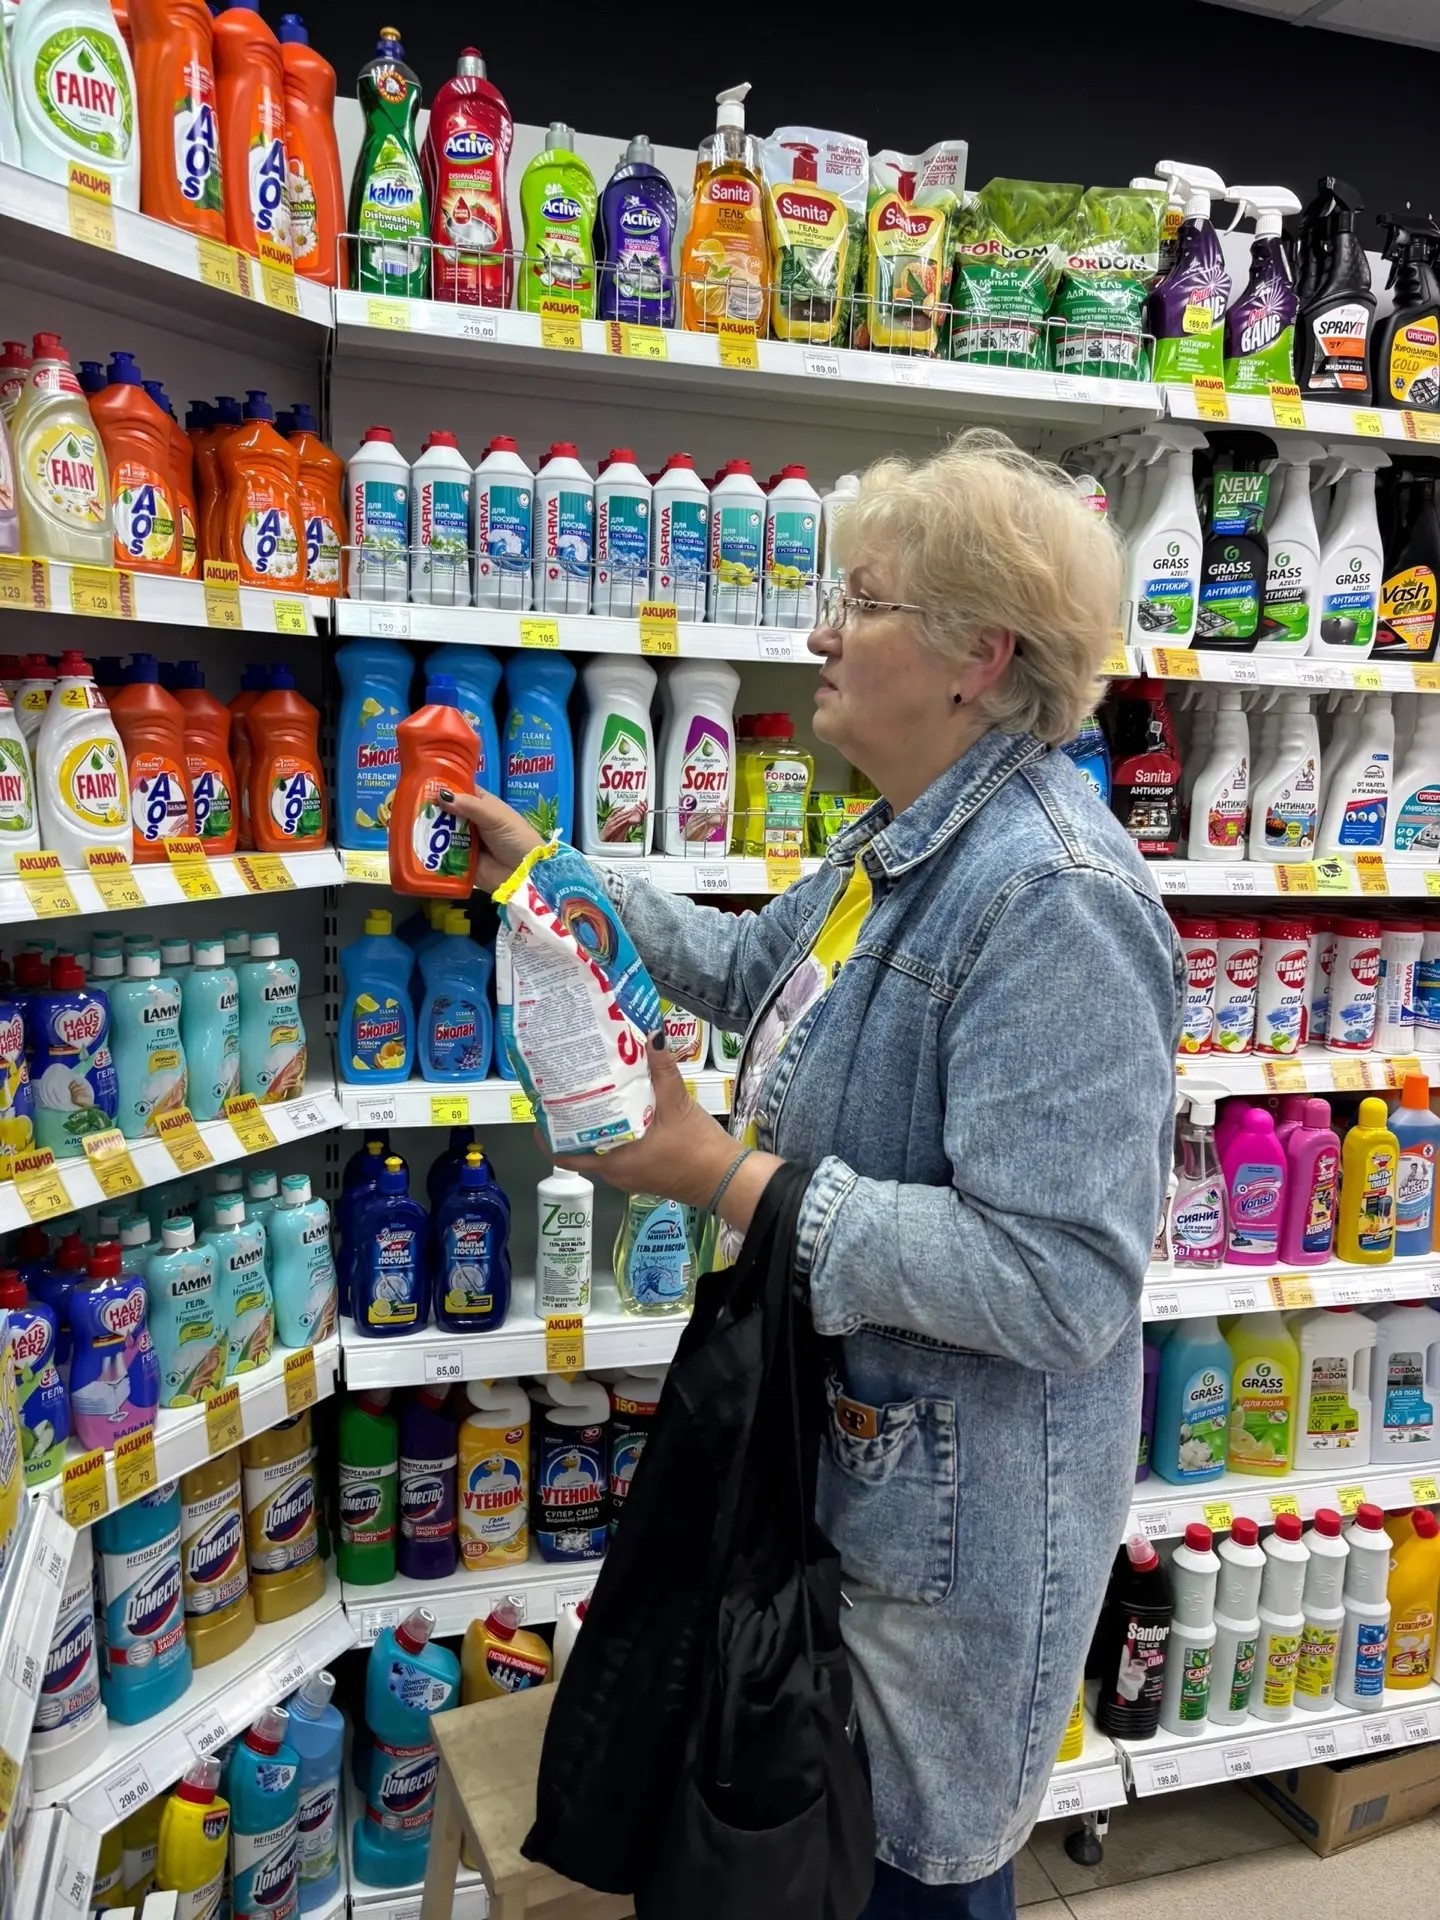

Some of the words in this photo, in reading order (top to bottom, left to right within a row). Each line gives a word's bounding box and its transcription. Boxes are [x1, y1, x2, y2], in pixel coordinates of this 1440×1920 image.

[56, 71, 116, 117] FAIRY
[446, 135, 494, 156] Active
[830, 153, 862, 164] ПОКУПКА
[826, 166, 843, 175] БЛОК
[70, 168, 111, 196] АКЦИЯ
[449, 174, 493, 183] DISHWASHING
[256, 141, 285, 231] AOS
[369, 178, 414, 204] kalyon
[712, 184, 750, 202] Sanita
[542, 201, 582, 217] Active
[718, 208, 744, 218] ГЕЛЬ
[782, 198, 828, 223] Sanita
[364, 210, 420, 229] Dishwashing
[622, 211, 661, 229] Active
[379, 221, 408, 233] Liquid
[94, 228, 110, 241] 219
[261, 244, 292, 266] АКЦИЯ
[542, 301, 579, 315] АКЦИЯ
[463, 326, 494, 337] 219,00
[1241, 314, 1280, 352] BANG
[1408, 331, 1435, 342] unicum
[563, 336, 575, 345] 99
[649, 346, 660, 355] 99
[736, 357, 751, 366] 149
[1392, 359, 1419, 371] GOLD
[811, 365, 838, 374] 189,00
[1212, 409, 1224, 417] 299
[51, 458, 95, 491] FAIRY
[1219, 476, 1264, 492] NEW
[1218, 490, 1263, 504] AZELIT
[356, 483, 364, 545] SARMA
[422, 483, 432, 545] SARMA
[435, 511, 464, 519] ПОСУДЫ
[480, 492, 489, 554] SARMA
[610, 524, 638, 532] ПОСУДЫ
[599, 502, 608, 561] SARMA
[660, 507, 670, 566] SARMA
[673, 529, 699, 538] ПОСУДЫ
[1153, 558, 1189, 570] GRASS
[1208, 561, 1251, 574] GRASS
[206, 566, 239, 581] АКЦИЯ
[1336, 574, 1370, 585] GRASS
[1149, 582, 1189, 593] АНТИЖИР
[1205, 584, 1252, 598] АНТИЖИР
[1383, 583, 1429, 604] Vash
[91, 597, 108, 608] 129
[1331, 595, 1370, 604] АНТИЖИР
[224, 611, 234, 621] 98
[642, 606, 677, 618] АКЦИЯ
[539, 634, 554, 643] 105
[657, 642, 672, 650] 109
[765, 647, 790, 656] 139,00
[1234, 671, 1256, 680] 329,00
[1366, 676, 1378, 686] 179
[508, 751, 554, 776] Биолан
[357, 772, 397, 780] АПЕЛЬСИН
[766, 771, 806, 781] FORDOM
[1135, 769, 1172, 783] Sanita
[77, 772, 117, 800] FAIRY
[364, 779, 391, 787] ЛИМОН
[507, 780, 539, 789] БАЛЬЗАМ
[1130, 786, 1173, 795] АНТИЖИР
[146, 772, 171, 840] AOS
[284, 771, 308, 834] AOS
[1274, 802, 1315, 810] АНТИНАГАР
[168, 843, 202, 854] АКЦИЯ
[19, 857, 60, 870] АКЦИЯ
[362, 870, 378, 878] 149
[200, 884, 211, 892] 89
[702, 879, 728, 889] 189,00
[1165, 881, 1186, 889] 199,00
[1232, 883, 1253, 891] 219,00
[122, 892, 139, 901] 129
[52, 899, 70, 909] 129
[1226, 957, 1260, 969] ПЕМО
[1403, 964, 1413, 1006] SARMA
[265, 984, 296, 1002] LAMM
[1354, 993, 1374, 1001] СОДА
[1281, 996, 1300, 1004] СОДА
[144, 1004, 180, 1023] LAMM
[64, 1012, 99, 1031] HAUS
[67, 1025, 99, 1042] HERZ
[156, 1028, 175, 1038] ГЕЛЬ
[357, 1020, 399, 1040] Биолан
[434, 1023, 475, 1041] Биолан
[370, 1111, 393, 1120] 99,00
[451, 1111, 462, 1119] 69
[160, 1112, 192, 1133] АКЦИЯ
[258, 1132, 269, 1142] 98
[14, 1152, 53, 1174] АКЦИЯ
[120, 1175, 132, 1185] 79
[1241, 1193, 1273, 1213] Vanish
[1177, 1210, 1219, 1224] СИЯНИЕ
[456, 1219, 487, 1231] Золушка
[1307, 1221, 1332, 1235] КОВРОВ
[652, 1245, 663, 1253] ДЛЯ
[664, 1243, 685, 1252] ПОСУДЫ
[230, 1248, 263, 1271] LAMM
[379, 1256, 411, 1264] ПОСУДЫ
[242, 1270, 259, 1282] ГЕЛЬ
[171, 1273, 212, 1296] LAMM
[109, 1294, 143, 1320] HAUS
[185, 1298, 205, 1310] ГЕЛЬ
[1157, 1304, 1178, 1314] 309,00
[1234, 1299, 1254, 1308] 239,00
[112, 1308, 144, 1330] HERZ
[548, 1319, 583, 1330] АКЦИЯ
[566, 1355, 576, 1365] 99
[436, 1365, 460, 1376] 85,00
[1390, 1366, 1422, 1374] FORDOM
[1242, 1378, 1283, 1388] GRASS
[1191, 1384, 1224, 1401] GRASS
[615, 1399, 638, 1414] 150
[584, 1428, 600, 1437] 30
[139, 1470, 150, 1482] 79
[462, 1485, 525, 1511] УТЕНОК
[542, 1486, 600, 1505] УТЕНОК
[1425, 1490, 1436, 1498] 159
[88, 1500, 100, 1513] 79
[188, 1485, 239, 1516] НЕПОБЕДИМЫЙ
[545, 1509, 573, 1518] СУПЕР
[575, 1506, 599, 1515] СИЛА
[1218, 1516, 1230, 1525] 175
[1145, 1524, 1166, 1534] 219,00
[126, 1530, 180, 1565] НЕПОБЕДИМЫЙ
[466, 1544, 483, 1552] БЕЗ
[1128, 1623, 1169, 1642] Sanfor
[489, 1651, 506, 1660] ГУСТОЙ
[22, 1657, 36, 1689] 259,00
[198, 1725, 226, 1751] 298,00
[1371, 1733, 1391, 1744] 169,00
[1409, 1727, 1429, 1738] 119,00
[1314, 1744, 1334, 1755] 159,00
[1230, 1762, 1251, 1773] 149,00
[1157, 1774, 1178, 1786] 199,00
[119, 1781, 149, 1808] 298,00
[1058, 1798, 1080, 1810] 279,00
[70, 1871, 86, 1901] 229,00
